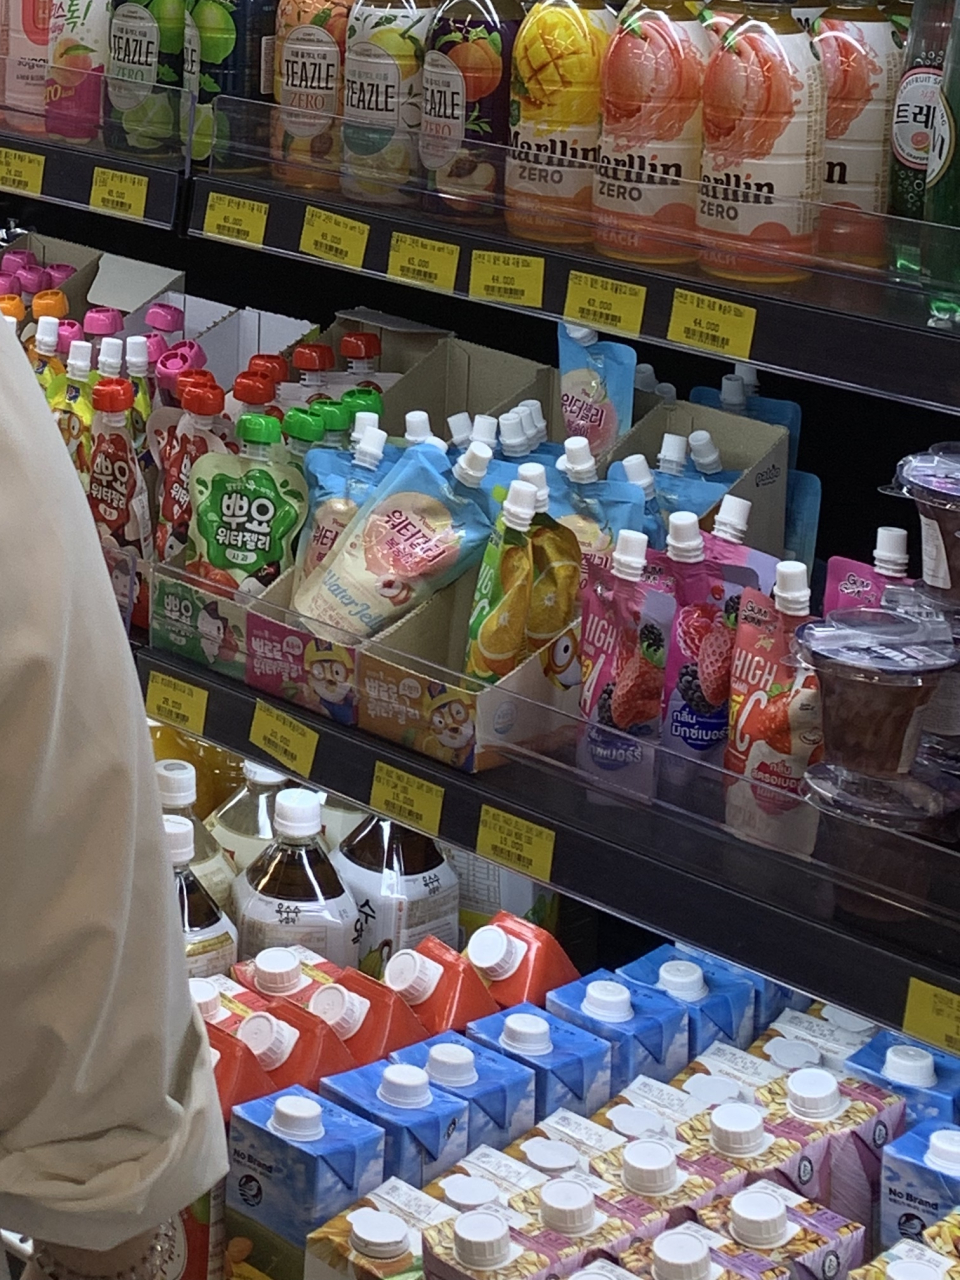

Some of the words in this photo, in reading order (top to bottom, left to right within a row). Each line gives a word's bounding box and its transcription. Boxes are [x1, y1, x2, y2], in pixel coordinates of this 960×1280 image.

[112, 34, 155, 67] TEAZLE
[115, 66, 145, 82] ZERO
[285, 59, 335, 91] TEAZLE
[289, 92, 326, 110] ZERO
[345, 79, 395, 113] TEAZLE
[423, 120, 452, 137] ZERO
[518, 165, 563, 184] ZERO
[599, 181, 643, 202] ZERO
[700, 199, 739, 221] ZERO
[596, 227, 639, 247] PEACH
[561, 393, 605, 427] 워터젤리
[221, 492, 275, 533] 뿌요
[216, 528, 271, 552] 워터젤리
[733, 647, 778, 692] HIGH
[422, 873, 442, 888] 옥수수
[276, 902, 302, 917] 옥수수
[233, 1148, 246, 1160] No
[247, 1156, 275, 1174] Brand
[888, 1187, 904, 1200] No
[906, 1192, 939, 1211] Brand
